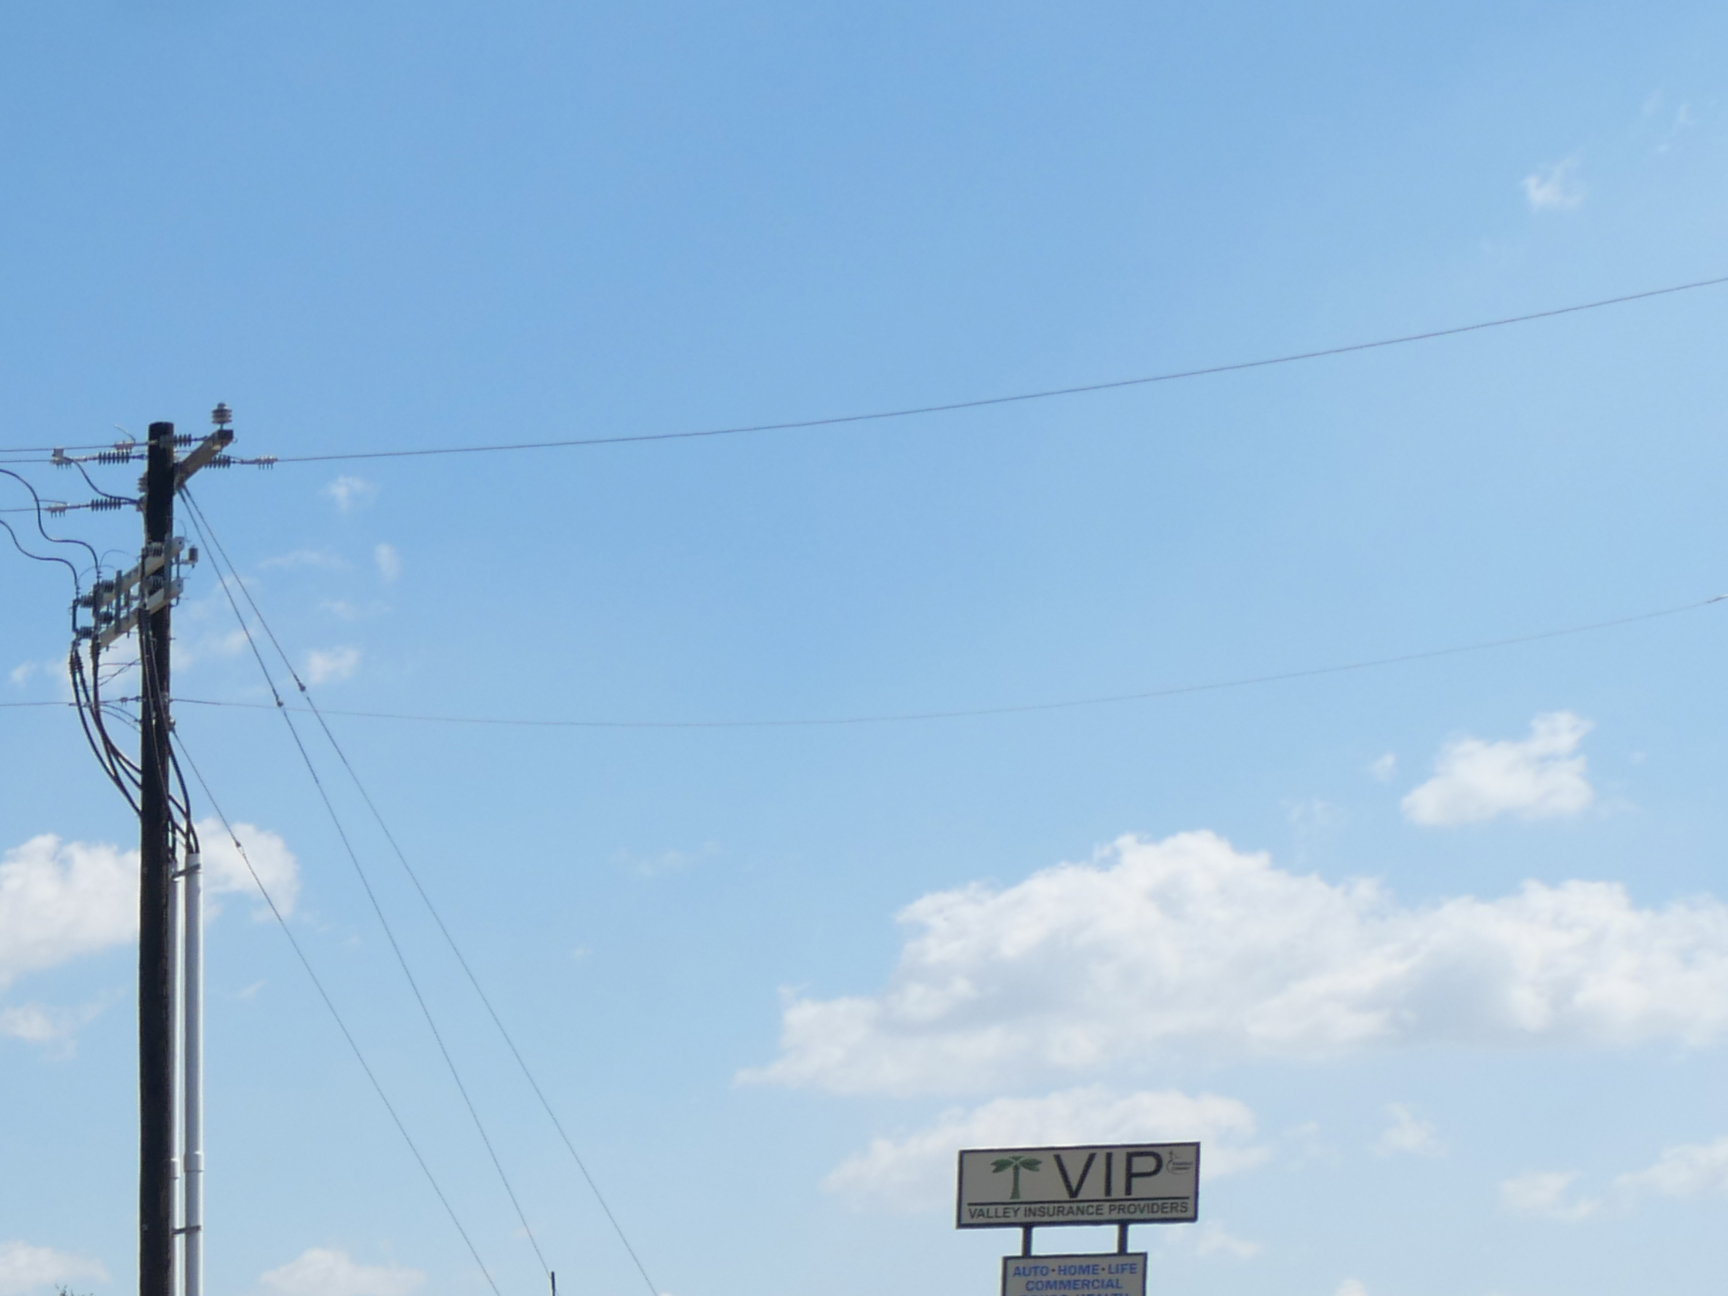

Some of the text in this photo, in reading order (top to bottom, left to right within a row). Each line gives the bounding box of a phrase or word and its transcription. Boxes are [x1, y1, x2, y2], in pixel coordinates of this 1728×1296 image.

[1054, 1151, 1163, 1198] VIP
[969, 1201, 1189, 1219] VALLEY INSURANCE PROVIDERS
[1013, 1263, 1138, 1277] AUTO HOME LIFE
[1025, 1279, 1123, 1291] COMMERCIAL
